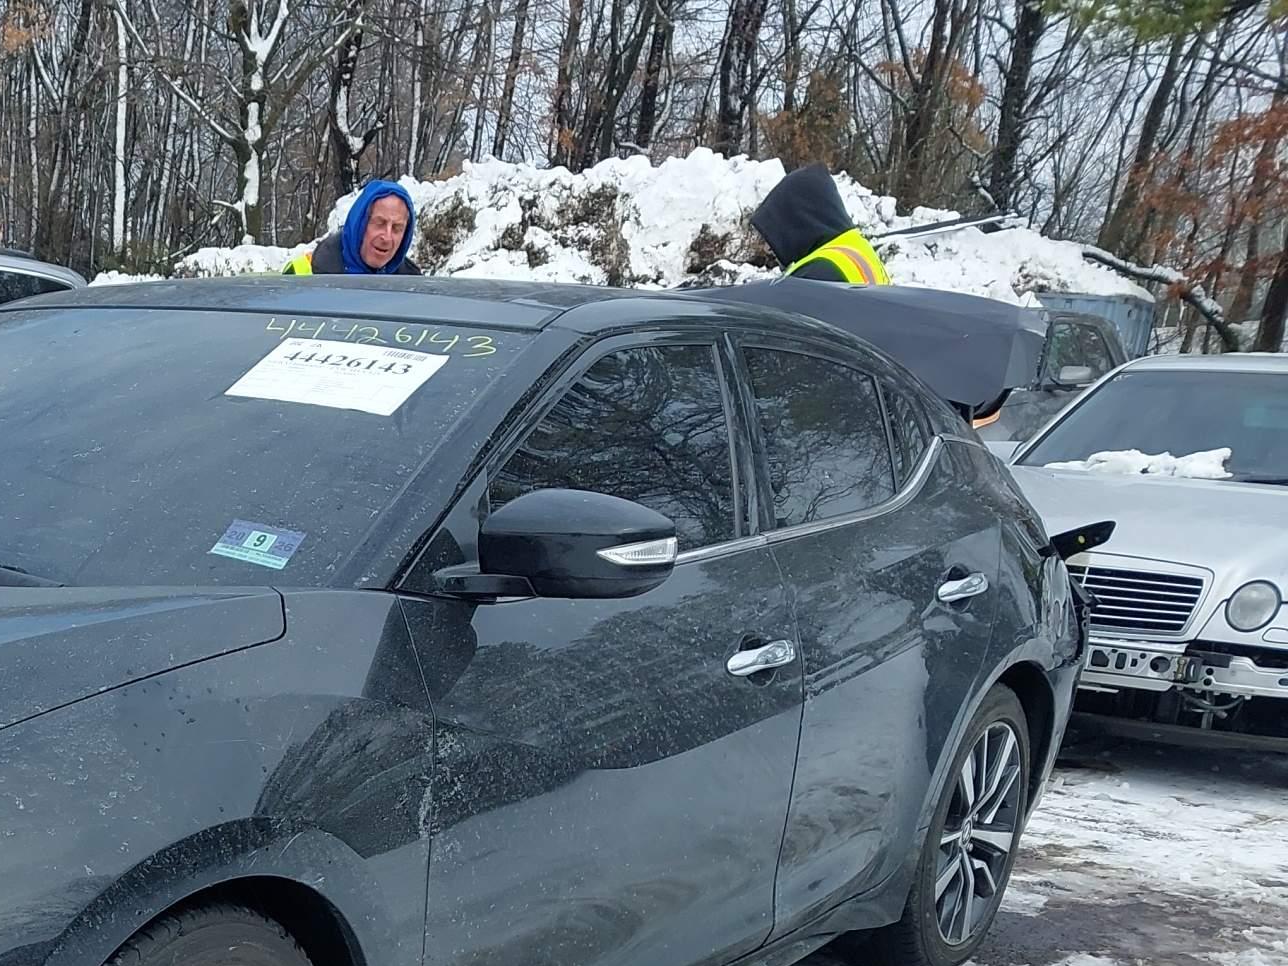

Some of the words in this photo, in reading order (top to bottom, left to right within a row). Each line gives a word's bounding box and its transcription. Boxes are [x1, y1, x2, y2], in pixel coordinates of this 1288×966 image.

[266, 317, 497, 358] 44426143
[283, 350, 413, 375] 44426143
[253, 534, 267, 547] 9
